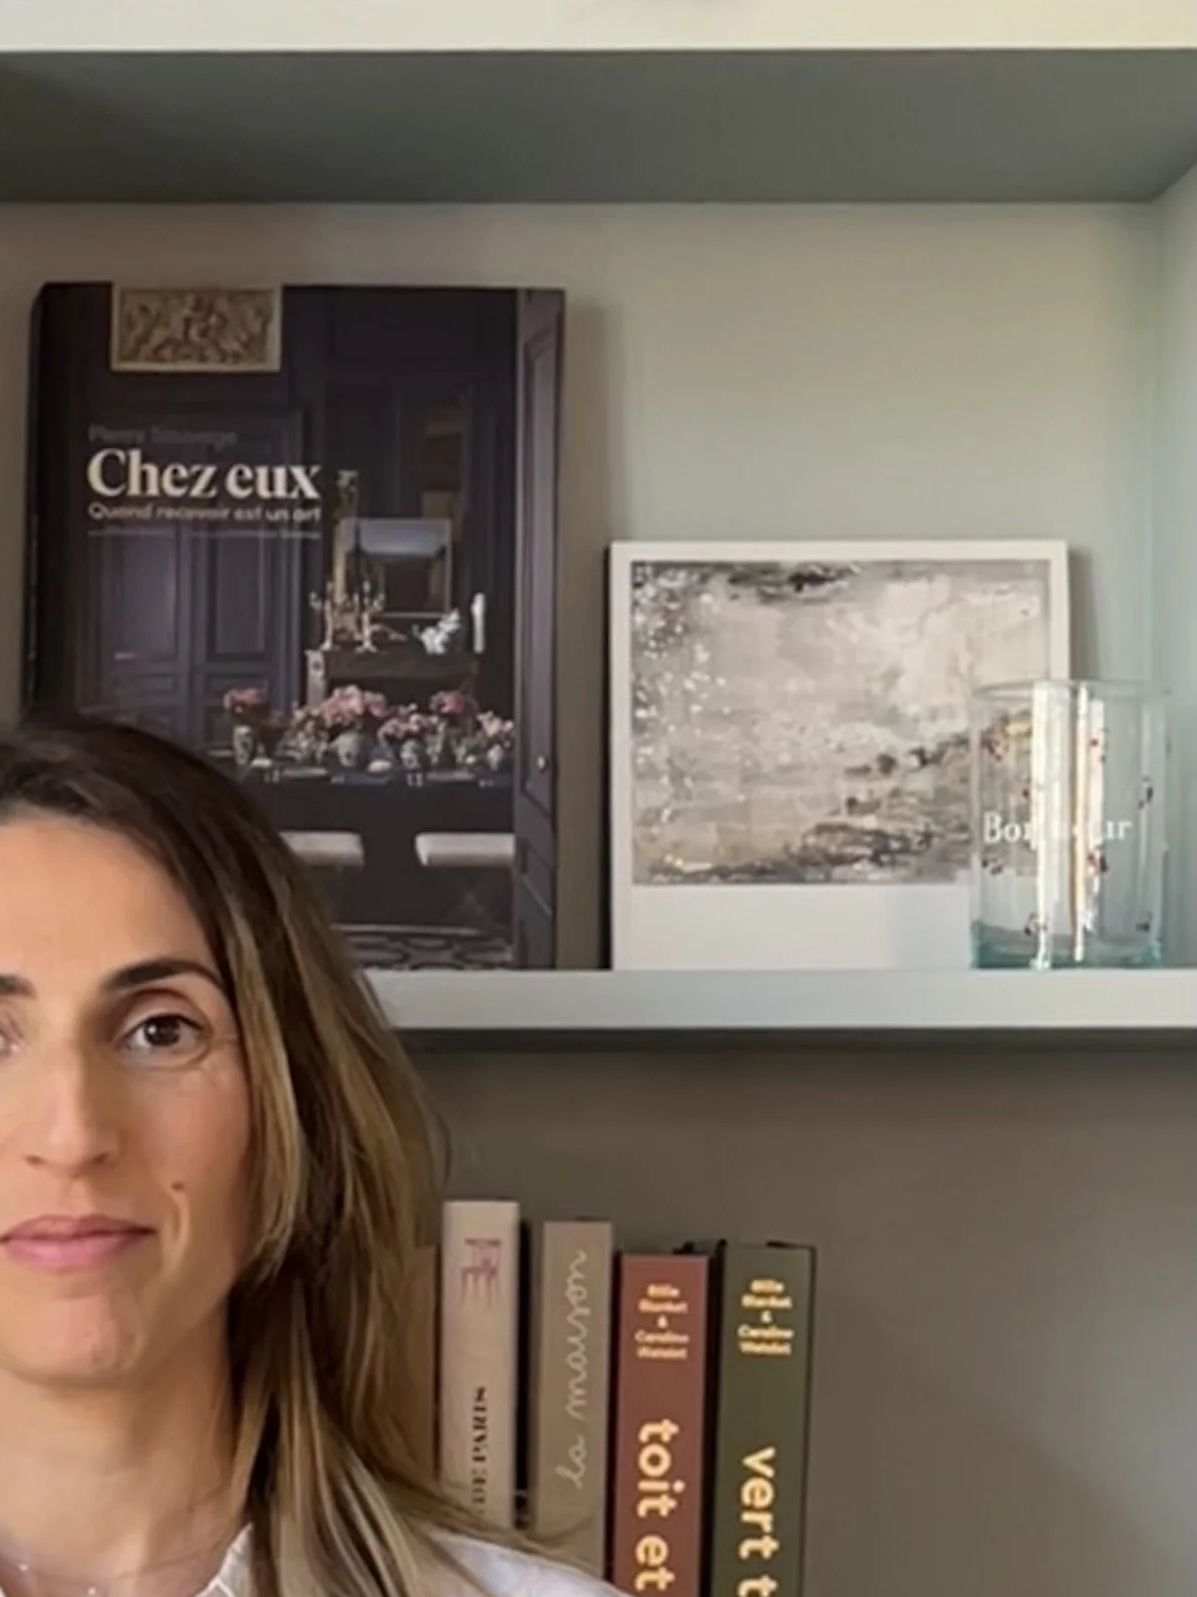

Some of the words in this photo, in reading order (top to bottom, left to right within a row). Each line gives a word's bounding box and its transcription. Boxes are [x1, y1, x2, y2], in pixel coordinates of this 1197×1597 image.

[87, 448, 218, 498] Chez
[225, 463, 322, 499] eux
[87, 502, 152, 521] Quand
[232, 505, 262, 522] est
[265, 508, 290, 522] un
[292, 507, 322, 523] art
[564, 1248, 591, 1421] maison
[471, 1385, 488, 1463] PARIS
[555, 1433, 588, 1489] la
[637, 1418, 686, 1518] toit
[738, 1446, 779, 1559] vert
[634, 1534, 675, 1591] et
